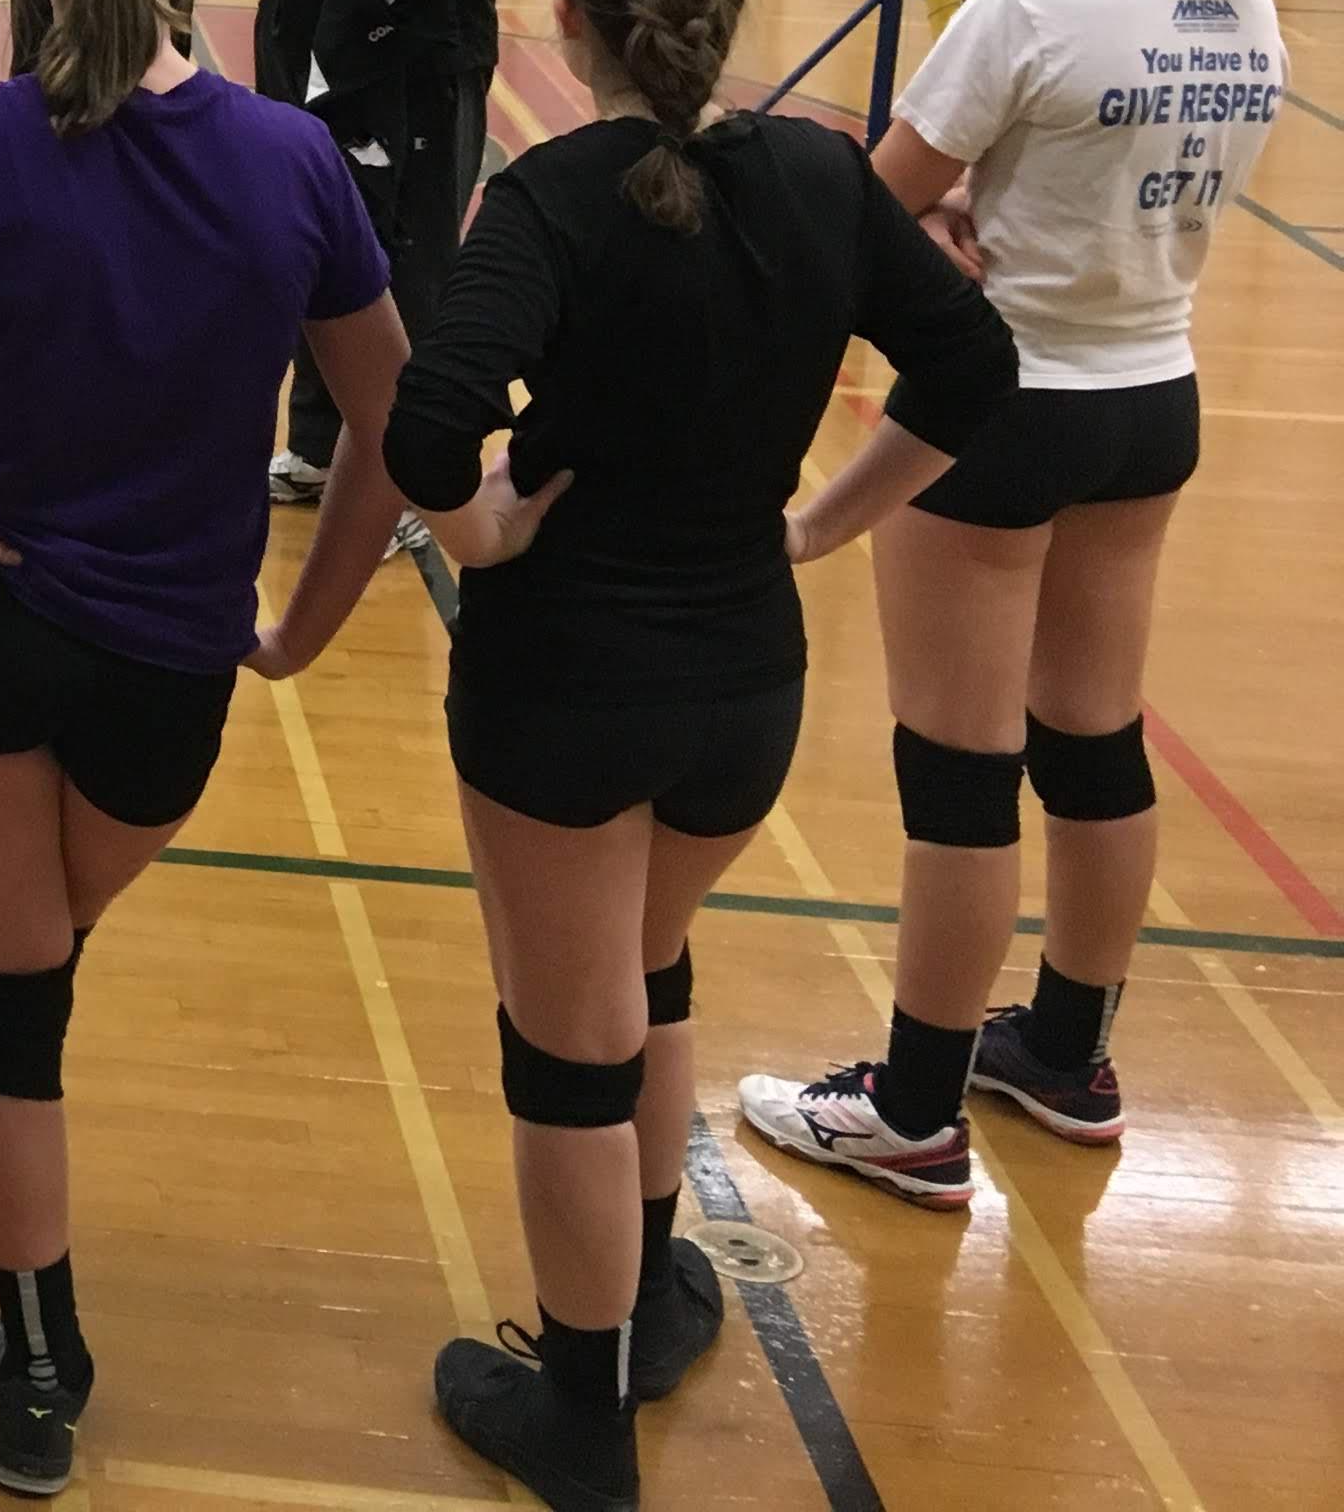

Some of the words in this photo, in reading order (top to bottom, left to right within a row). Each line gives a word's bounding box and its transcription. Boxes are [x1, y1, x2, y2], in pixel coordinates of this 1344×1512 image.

[1140, 47, 1183, 74] You
[1189, 46, 1242, 72] Have
[1248, 46, 1269, 73] to
[1098, 85, 1174, 127] GIVE
[1179, 83, 1282, 123] RESPEC
[1181, 131, 1206, 158] to
[1139, 170, 1196, 210] GET
[1194, 169, 1223, 207] IT
